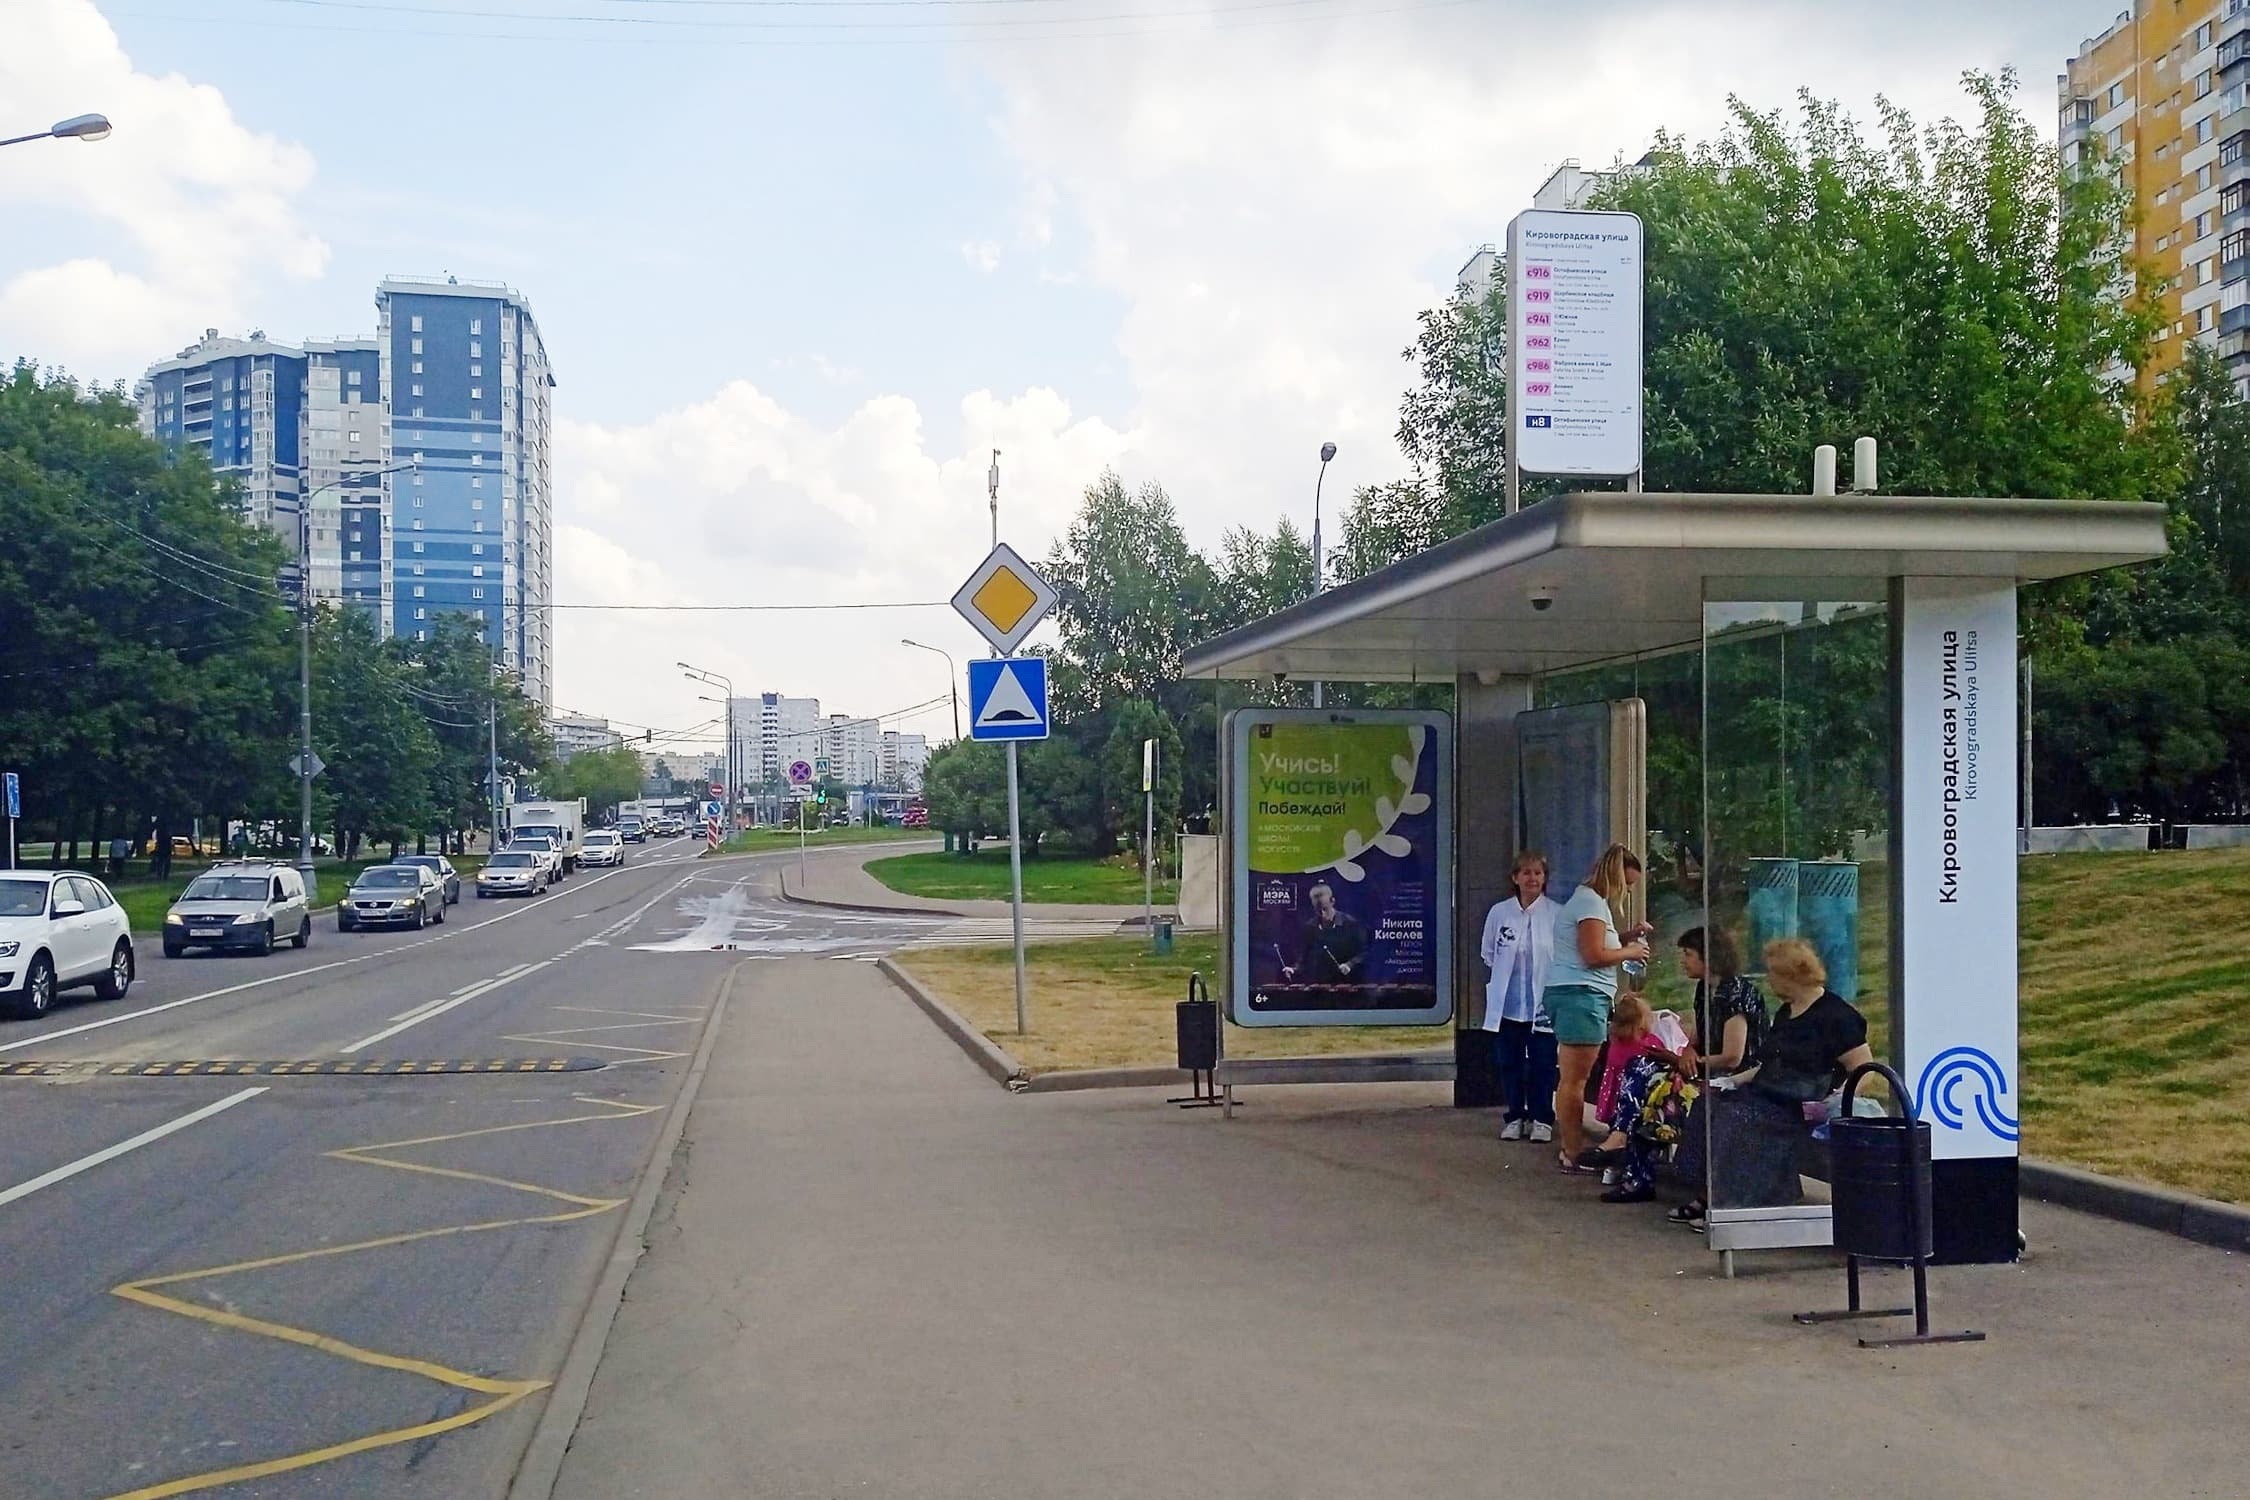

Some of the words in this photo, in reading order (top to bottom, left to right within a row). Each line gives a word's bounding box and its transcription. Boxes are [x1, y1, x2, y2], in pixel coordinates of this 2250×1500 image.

[1525, 230, 1599, 242] Кировоградская
[1602, 234, 1629, 242] улица
[1527, 268, 1549, 278] с916
[1527, 291, 1549, 301] с919
[1527, 314, 1549, 324] с941
[1527, 338, 1549, 347] с962
[1527, 384, 1549, 394] с997
[1964, 630, 1978, 671] Ulitsa
[1943, 630, 1961, 701] улица
[1964, 676, 1980, 800] Kirovogradskaya
[1259, 752, 1340, 774] Учись!
[1259, 776, 1371, 797] Участвуй!
[1259, 801, 1346, 817] Побеждай!
[1939, 707, 1961, 903] Кировоградская
[1263, 891, 1290, 899] МЭРА
[1382, 918, 1423, 929] Никита
[1374, 929, 1424, 940] Киселев
[1255, 992, 1268, 1004] 6+
